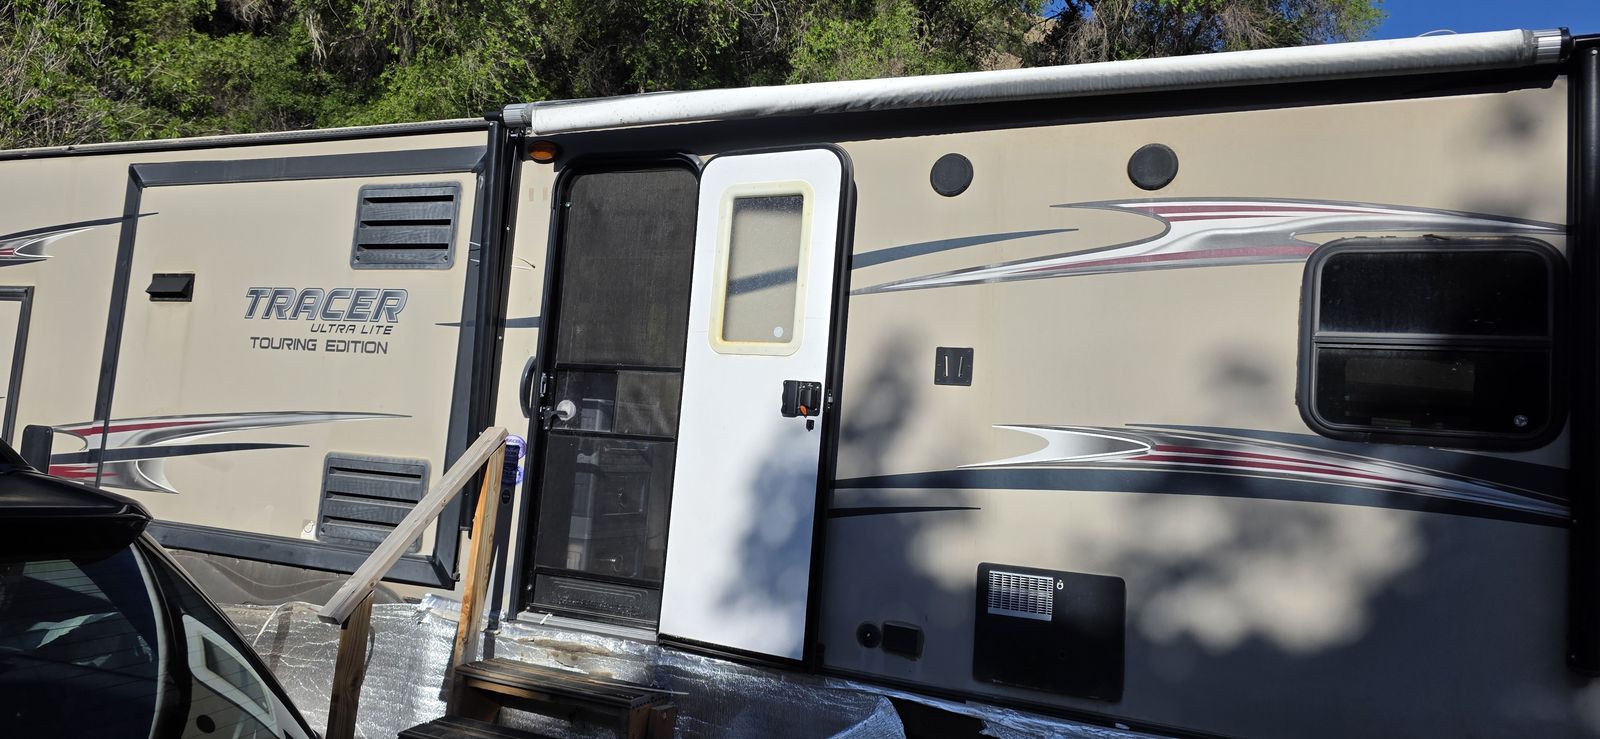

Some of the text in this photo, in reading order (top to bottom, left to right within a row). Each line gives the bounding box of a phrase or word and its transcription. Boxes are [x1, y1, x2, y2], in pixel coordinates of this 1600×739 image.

[244, 287, 409, 323] TRACER
[310, 323, 394, 335] ULTRA LITE
[250, 336, 389, 355] TOURING EDITION
